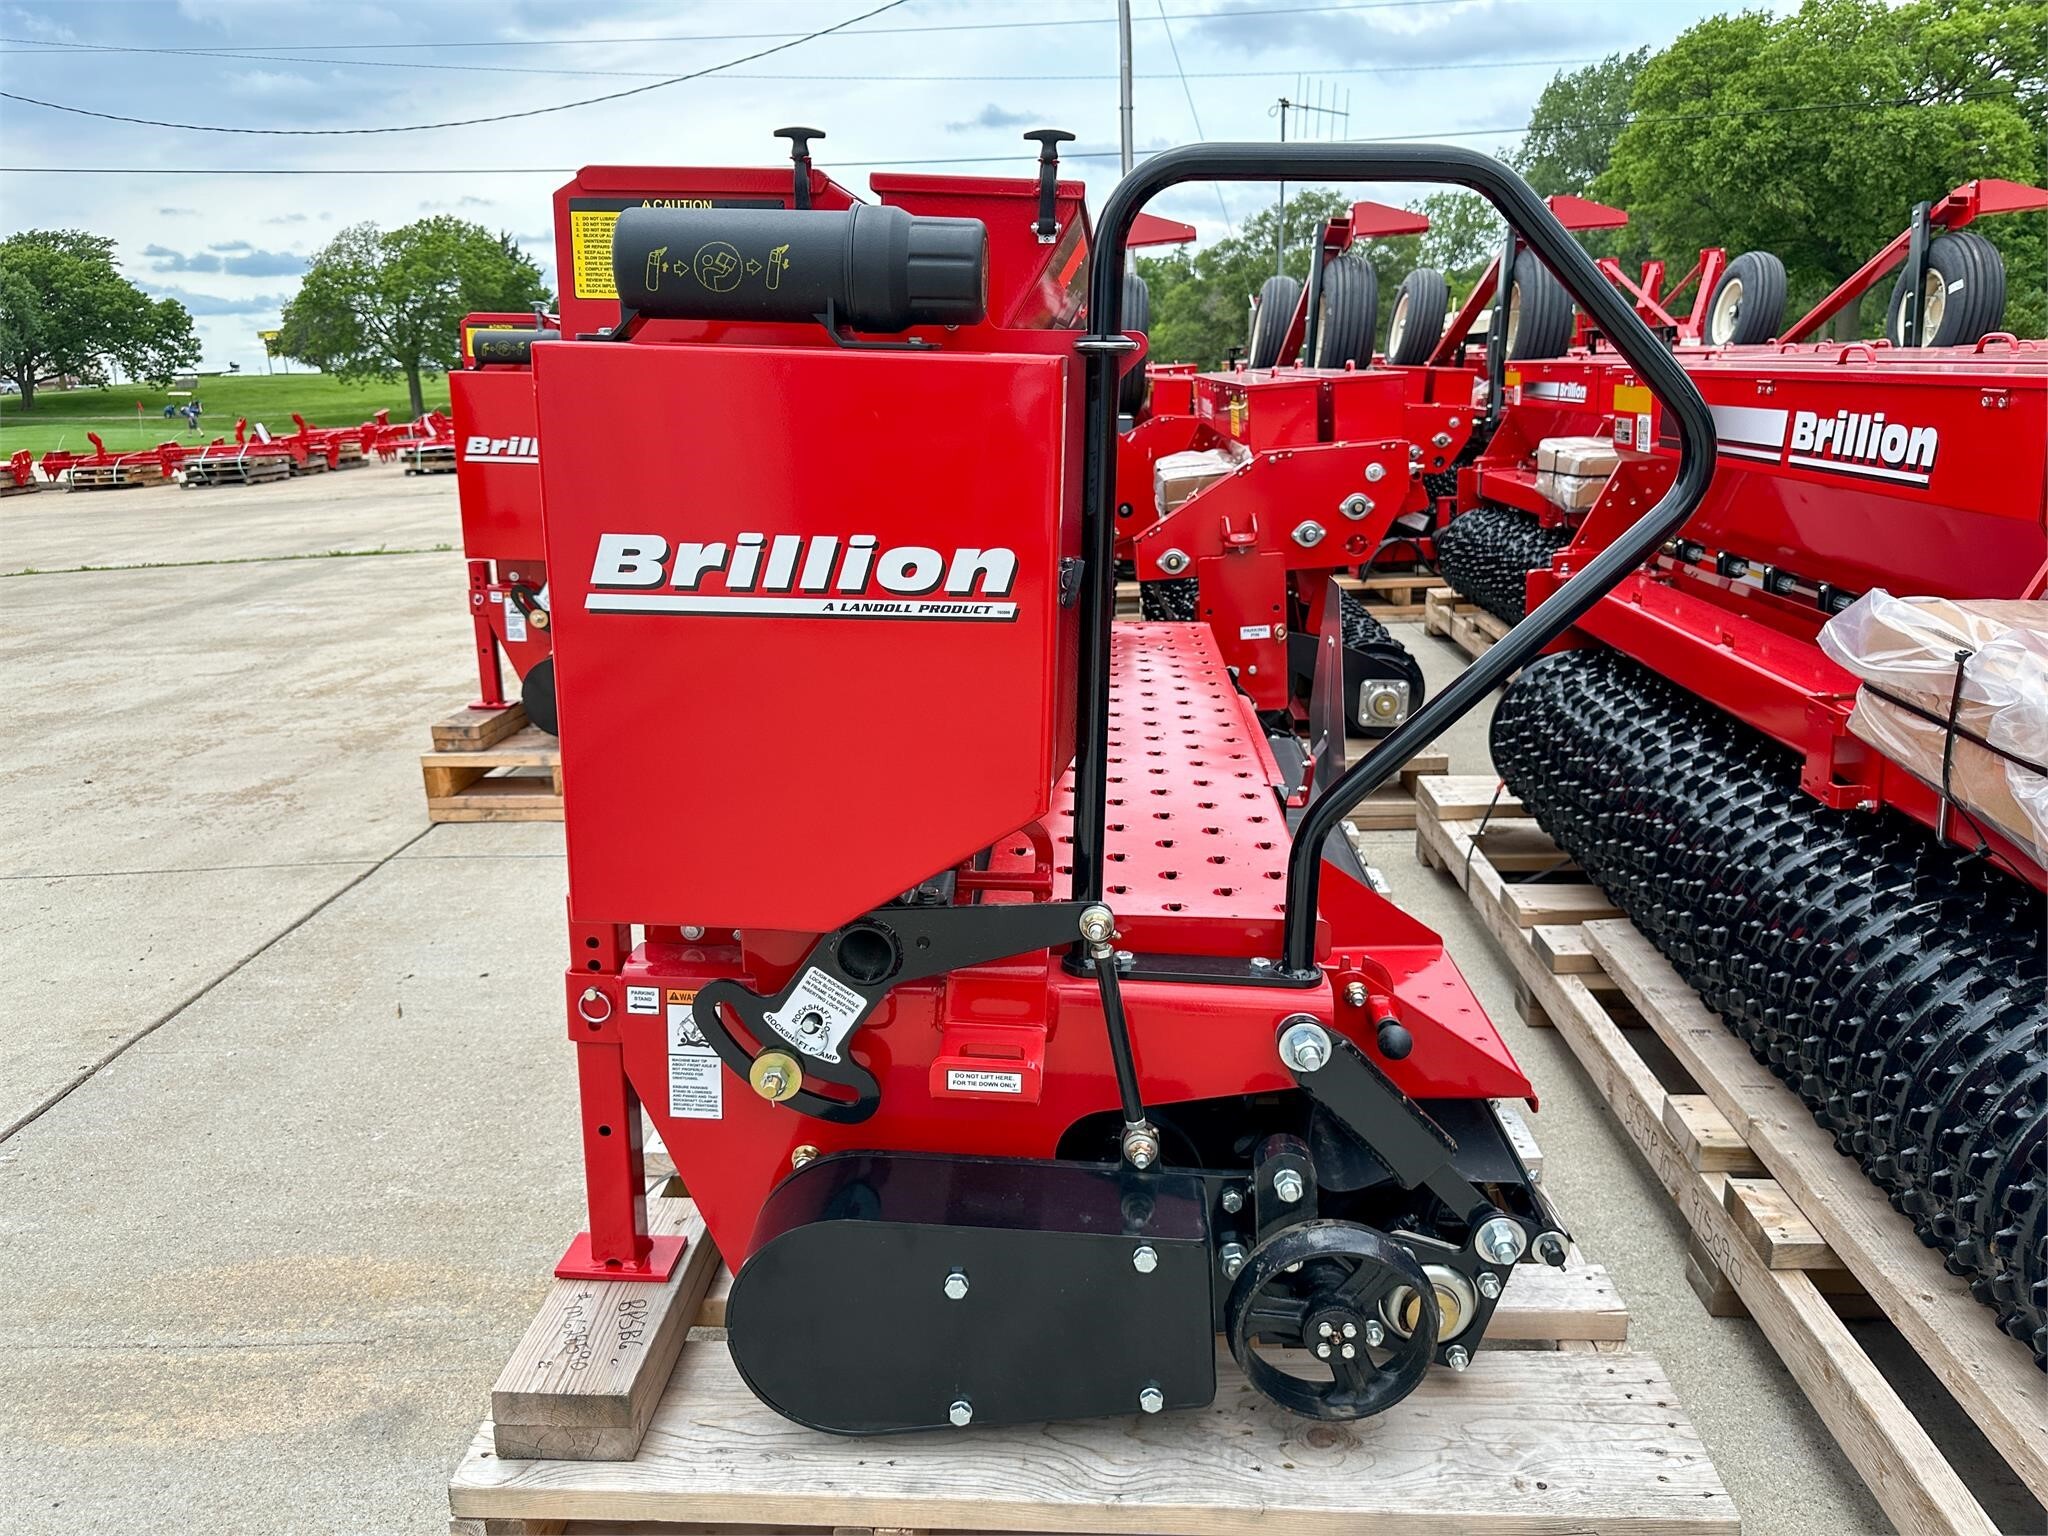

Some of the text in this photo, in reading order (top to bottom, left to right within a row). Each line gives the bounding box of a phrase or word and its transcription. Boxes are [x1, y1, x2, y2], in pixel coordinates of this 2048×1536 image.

[653, 200, 712, 208] CAUTION
[1559, 382, 1587, 398] Brillion
[1790, 410, 1938, 468] Brillion
[589, 533, 1018, 595] Brillion
[823, 602, 834, 611] A
[840, 603, 912, 613] LANDOLL
[918, 604, 992, 614] PRODUCT
[809, 975, 822, 986] LOCK
[822, 983, 834, 994] SLOT
[834, 990, 846, 1001] WITH
[812, 970, 855, 998] ALIGN ROCKSHAFT
[802, 986, 826, 1003] INSERTING
[825, 1000, 840, 1012] LOCK
[810, 983, 827, 996] FRAME
[827, 993, 837, 1001] TAB
[836, 999, 855, 1014] BEFORE
[792, 1004, 831, 1024] ROCKSHAFT
[809, 1047, 837, 1061] CAMP
